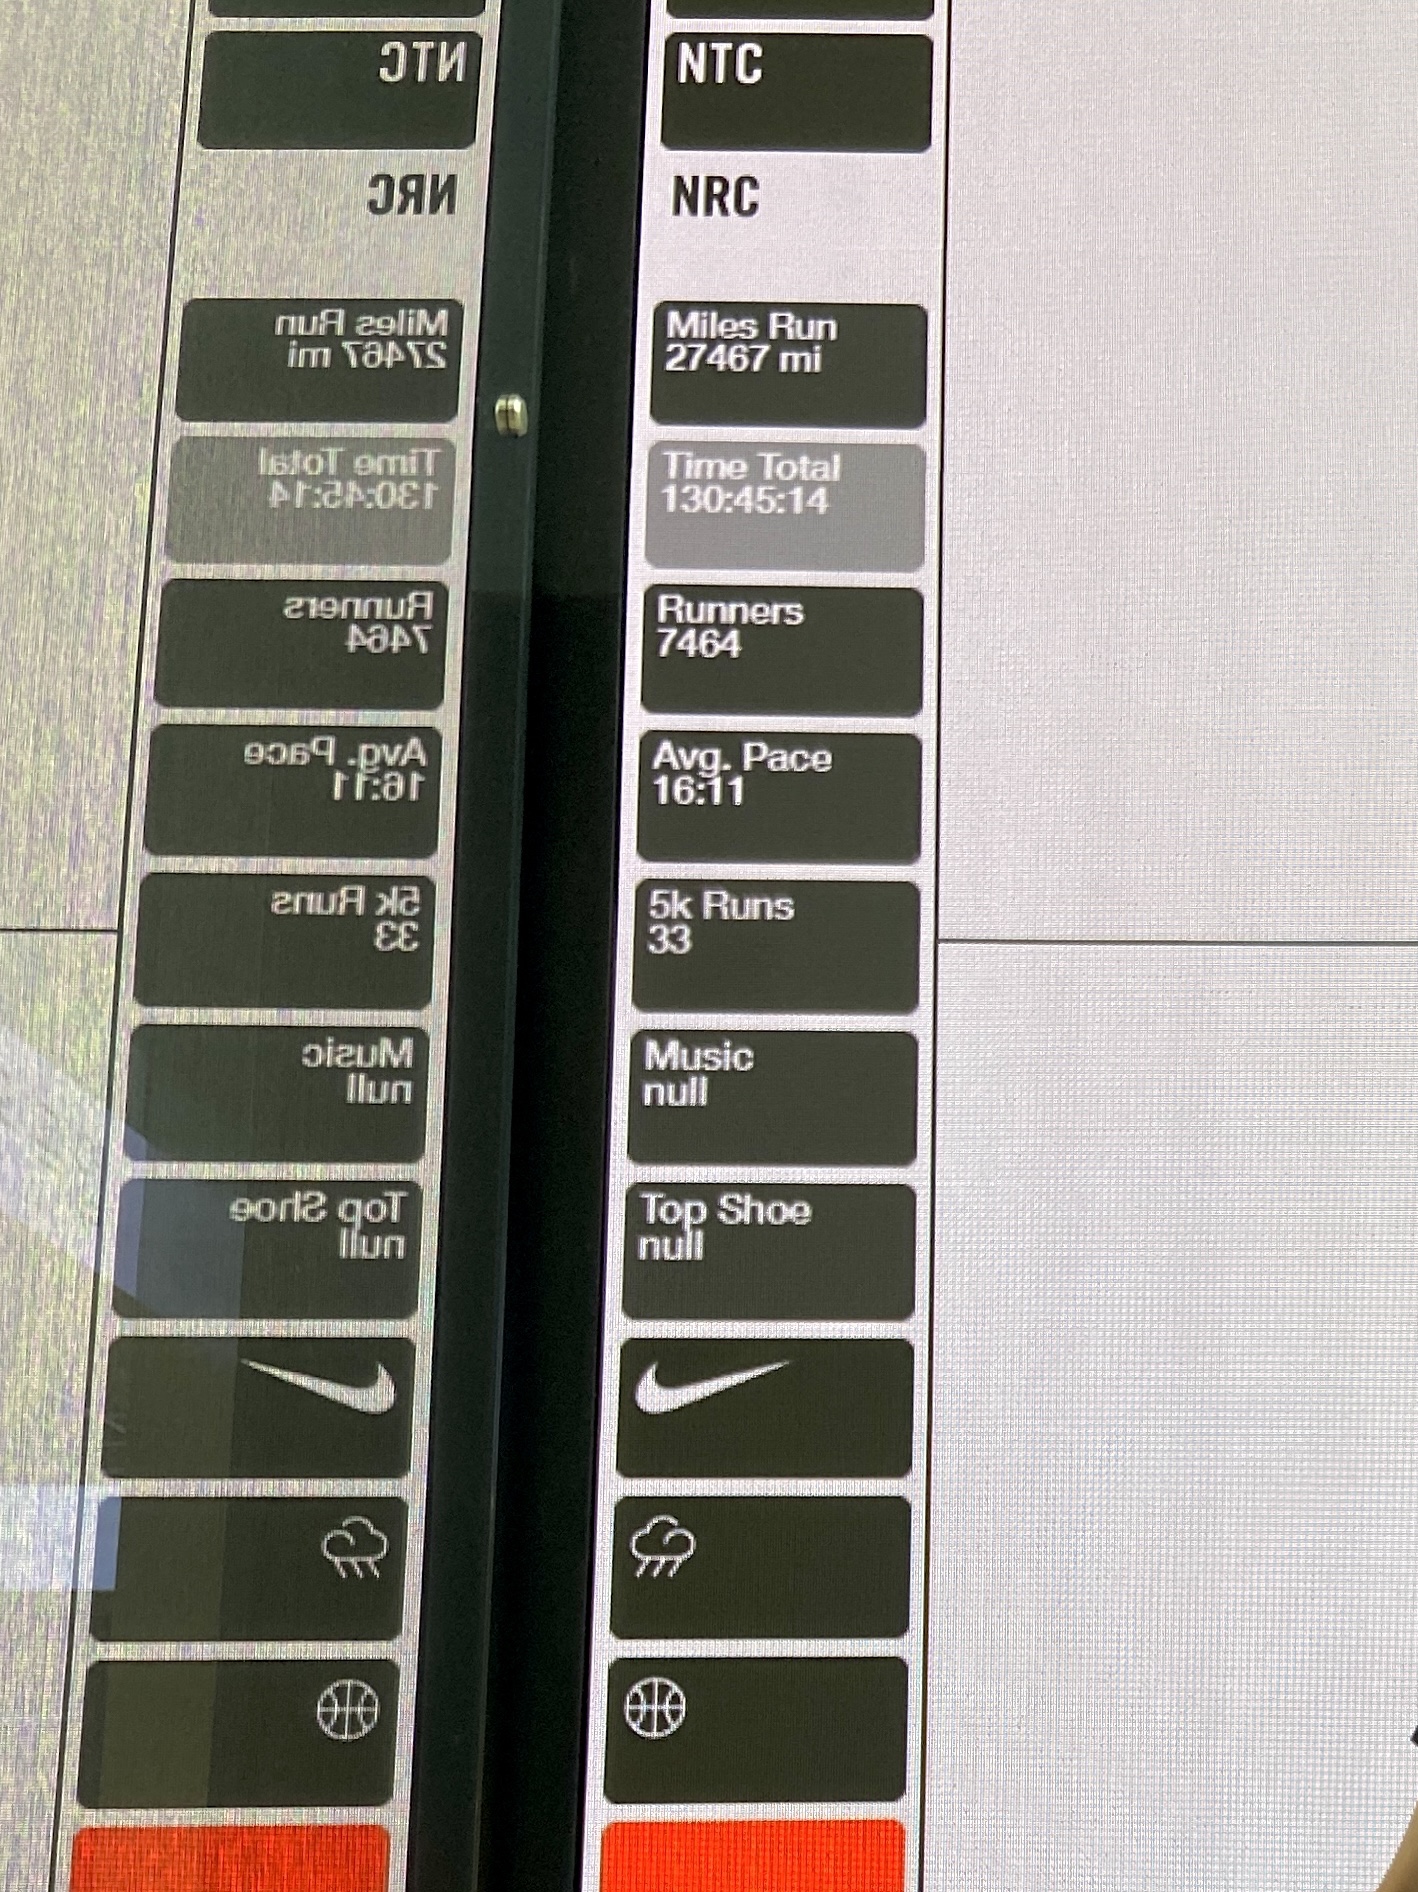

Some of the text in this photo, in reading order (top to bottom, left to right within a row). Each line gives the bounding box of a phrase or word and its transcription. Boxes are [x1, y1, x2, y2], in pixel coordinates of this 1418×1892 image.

[678, 41, 763, 84] NTC
[672, 174, 760, 218] NRC
[667, 310, 838, 341] Miles Run
[665, 342, 822, 373] 27467 mi
[662, 450, 841, 482] Time Total
[661, 483, 829, 515] 130:45:14
[657, 593, 805, 626] Runners
[657, 627, 742, 658] 7464
[652, 739, 833, 779] Avg. Pace
[653, 771, 743, 806] 16:11
[649, 888, 795, 921] 5k Runs
[648, 923, 693, 955] 33
[645, 1039, 754, 1071] Music
[643, 1075, 708, 1107] null
[640, 1192, 812, 1234] Top Shoe
[638, 1229, 704, 1261] null
